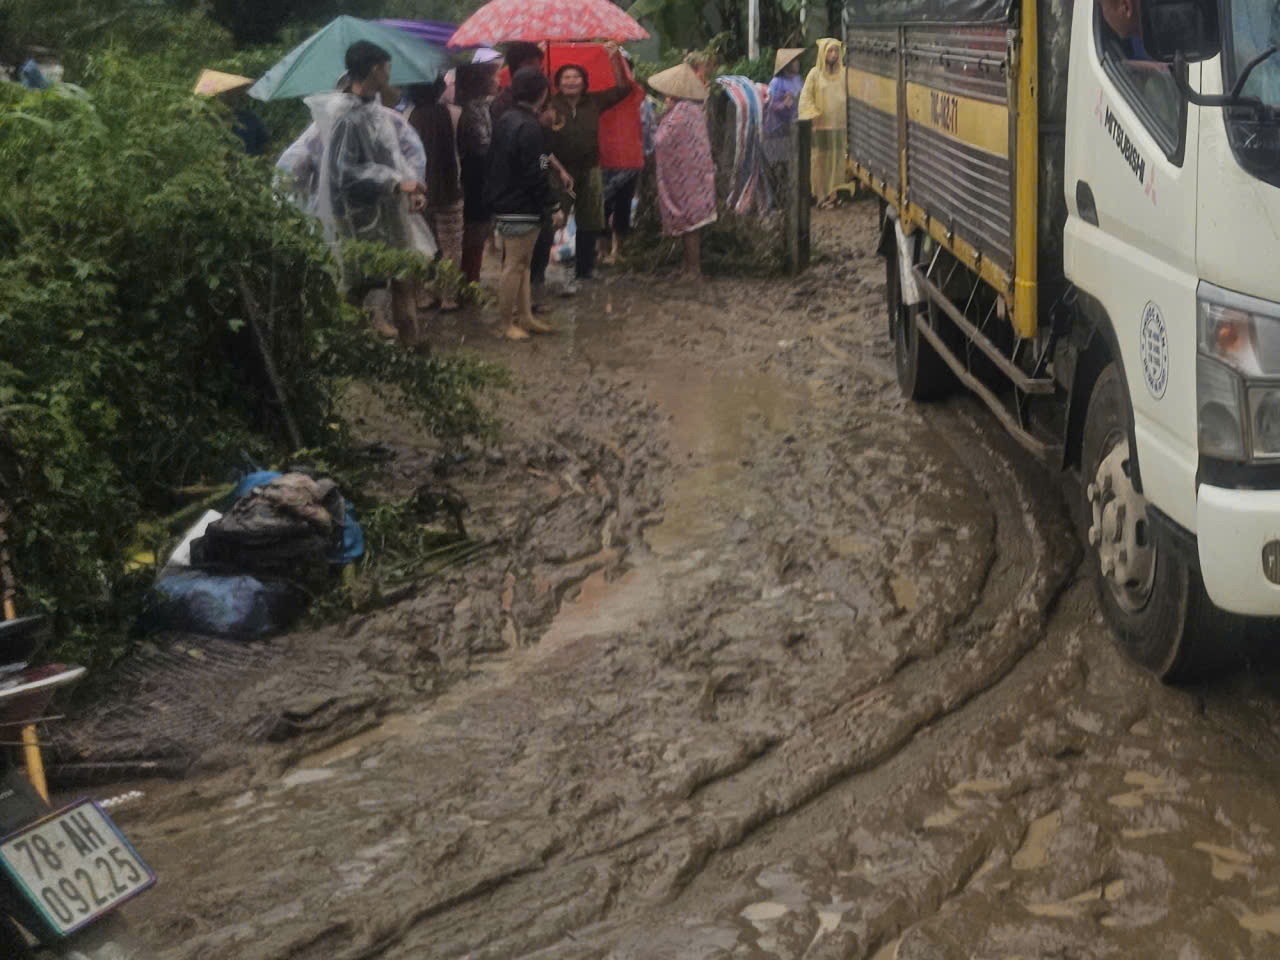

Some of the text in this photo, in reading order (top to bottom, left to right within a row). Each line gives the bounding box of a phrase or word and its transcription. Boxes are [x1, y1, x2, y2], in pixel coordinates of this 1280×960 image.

[1104, 104, 1145, 184] MITSUBISHI
[13, 811, 107, 881] 78-AH
[41, 846, 141, 924] 092.25
